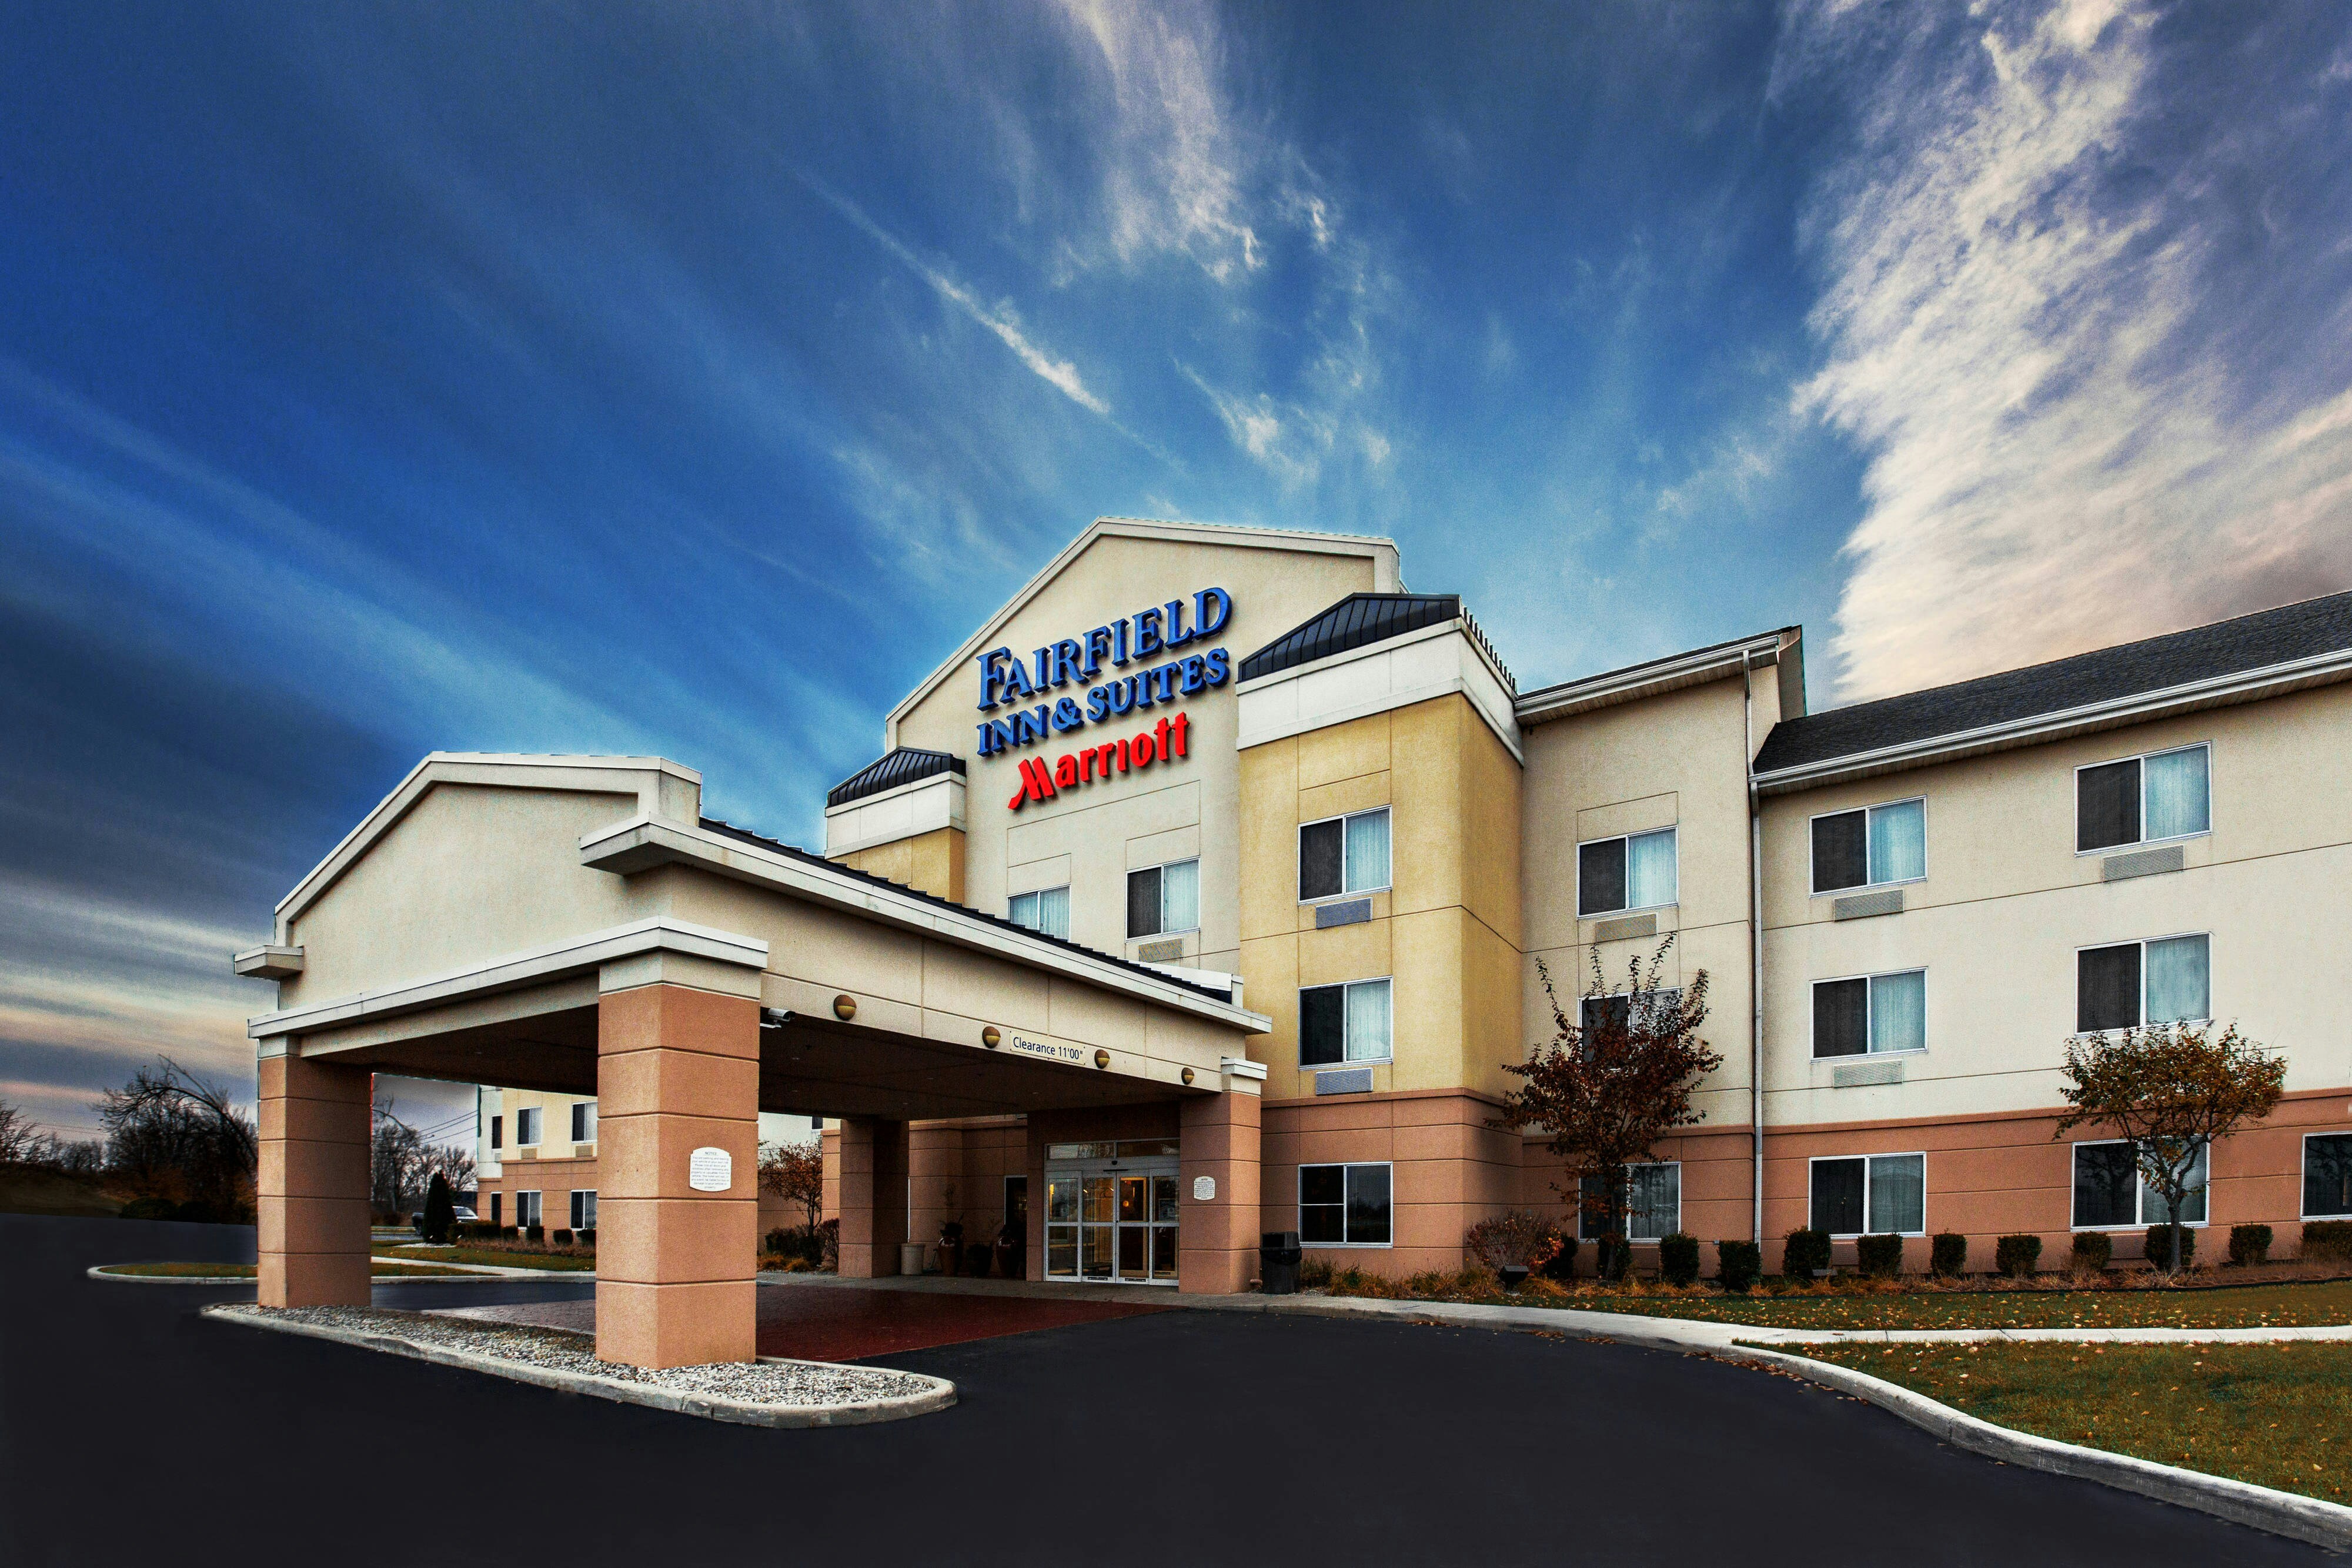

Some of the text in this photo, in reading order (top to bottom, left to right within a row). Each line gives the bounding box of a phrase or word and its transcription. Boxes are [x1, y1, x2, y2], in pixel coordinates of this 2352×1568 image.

[977, 587, 1232, 711] FAIRFIELD
[977, 647, 1230, 757] INN & SUITES
[1008, 711, 1190, 810] Marriott
[1013, 1037, 1083, 1059] Clearance 11'00"
